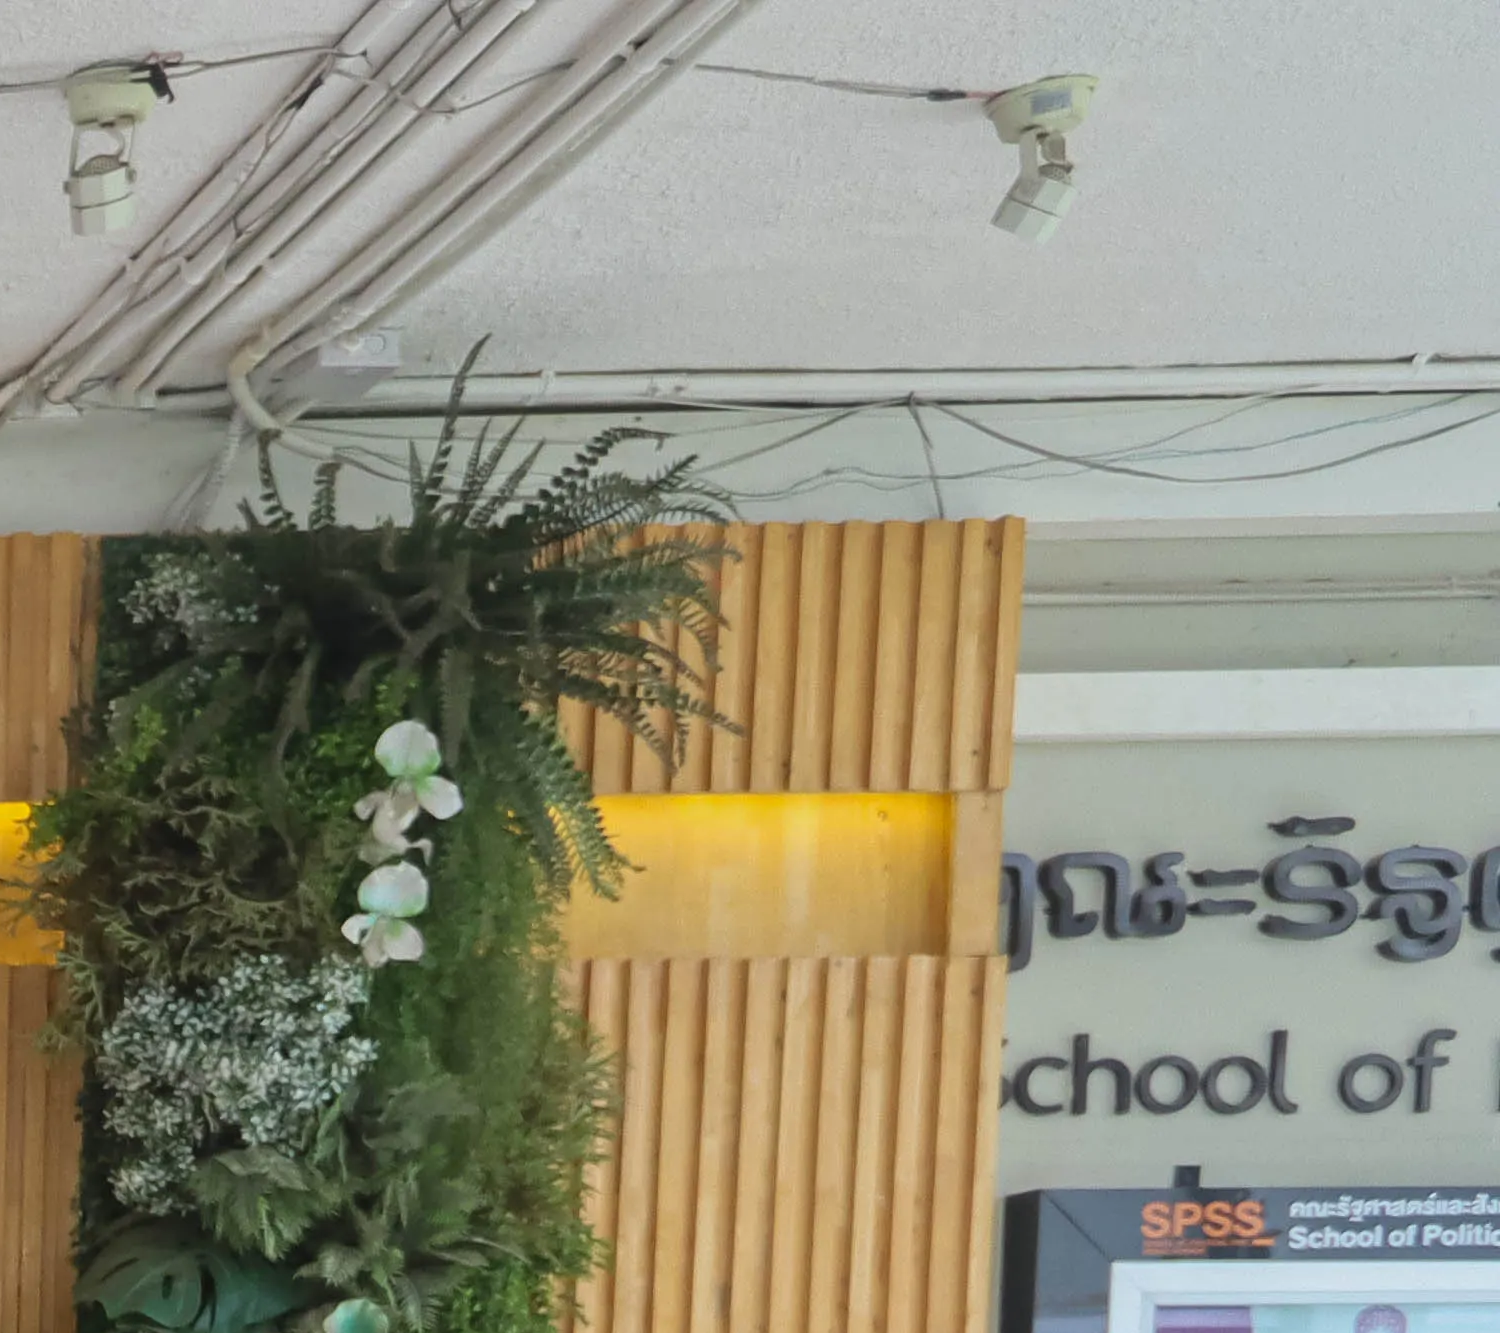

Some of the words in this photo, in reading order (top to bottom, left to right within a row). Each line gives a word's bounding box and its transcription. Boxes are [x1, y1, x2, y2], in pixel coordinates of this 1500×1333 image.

[998, 1029, 1298, 1116] chool
[1336, 1027, 1458, 1114] of
[1140, 1199, 1267, 1239] SPSS
[1289, 1192, 1500, 1222] คณะรัฐศาสตร์และสัง
[1288, 1224, 1384, 1249] School
[1389, 1223, 1418, 1247] of
